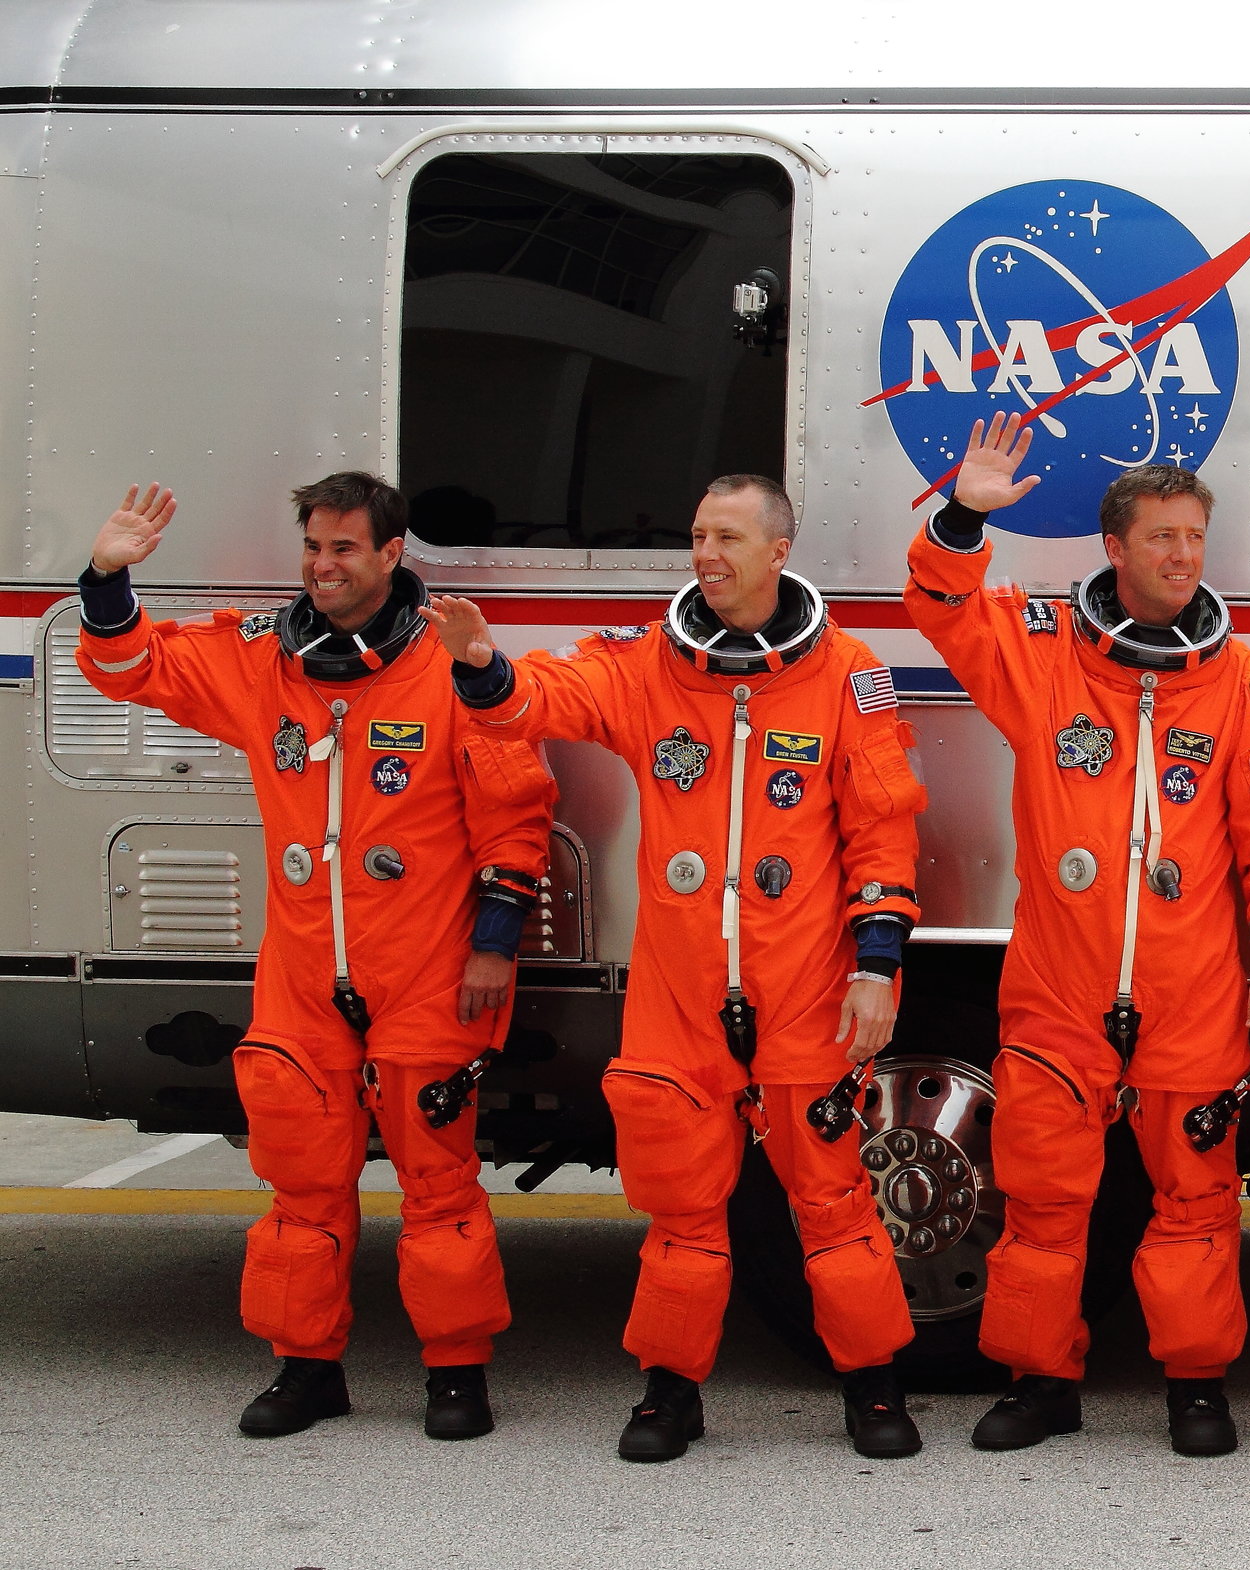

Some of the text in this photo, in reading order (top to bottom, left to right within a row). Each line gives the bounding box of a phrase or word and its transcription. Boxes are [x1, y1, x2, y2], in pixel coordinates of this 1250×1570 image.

[904, 319, 1222, 397] NASA
[377, 771, 407, 782] NASA
[772, 784, 801, 796] NASA
[1167, 778, 1195, 792] NASA
